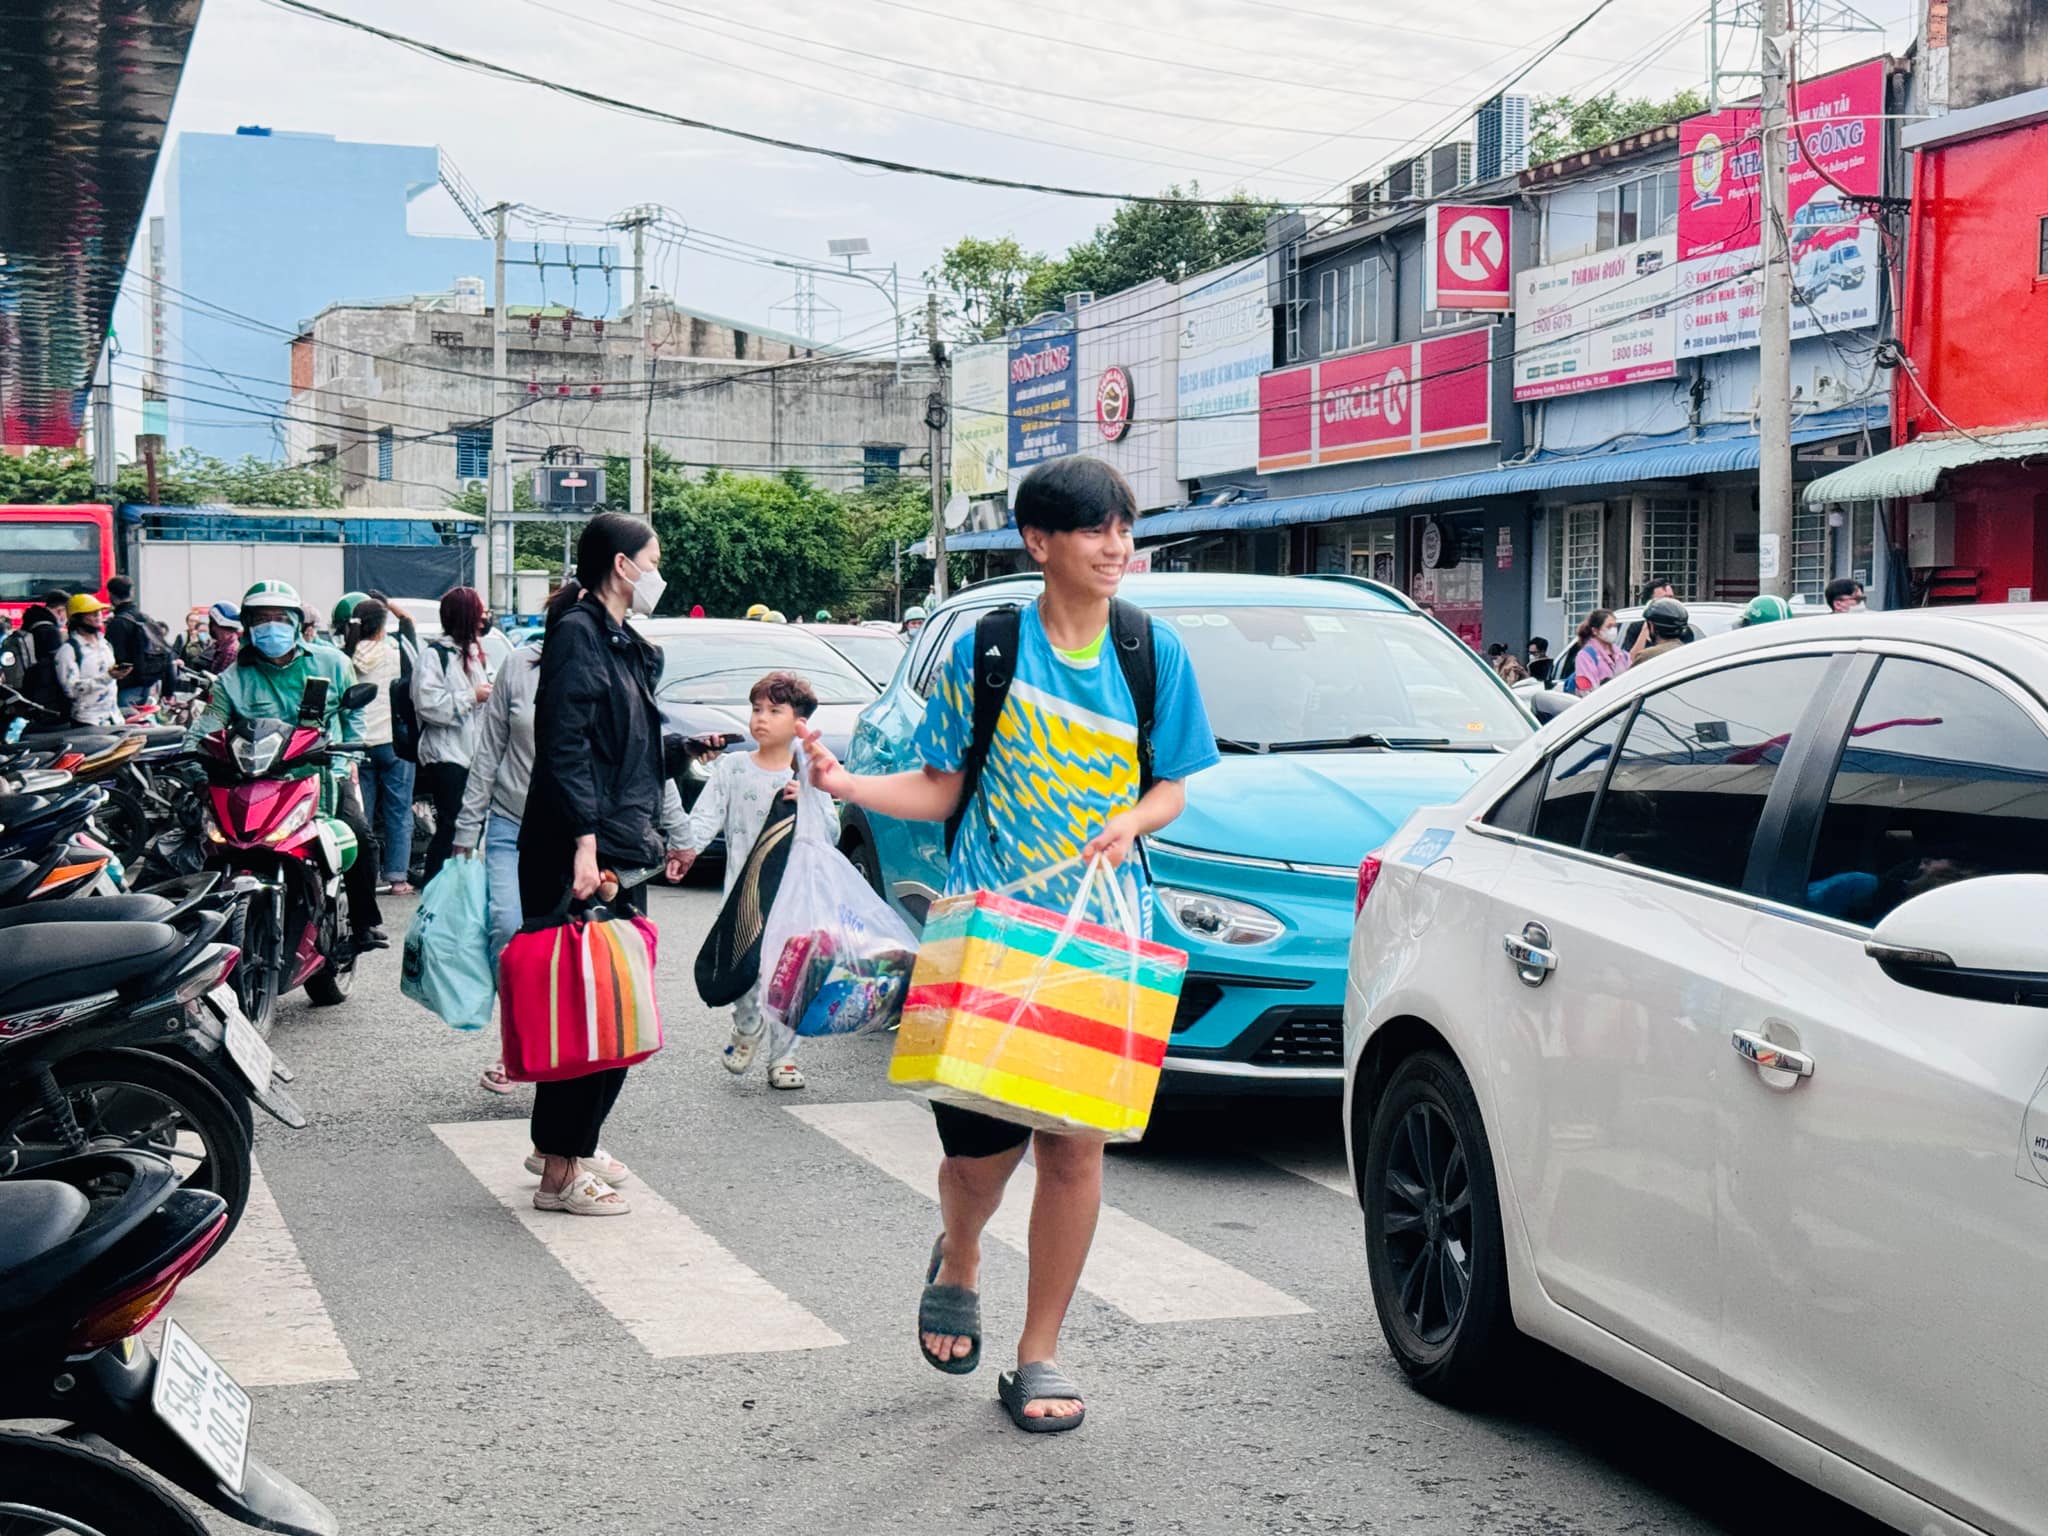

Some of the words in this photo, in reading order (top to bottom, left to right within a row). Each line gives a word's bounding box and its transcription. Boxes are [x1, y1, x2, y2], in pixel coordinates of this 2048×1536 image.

[1813, 101, 1831, 119] VẬN
[1833, 94, 1850, 116] TẢI
[1806, 121, 1866, 158] CÔNG
[1612, 345, 1631, 361] 1800
[1633, 342, 1652, 358] 6364
[1323, 382, 1380, 424] CIRCLE
[203, 1370, 247, 1480] 480.36
